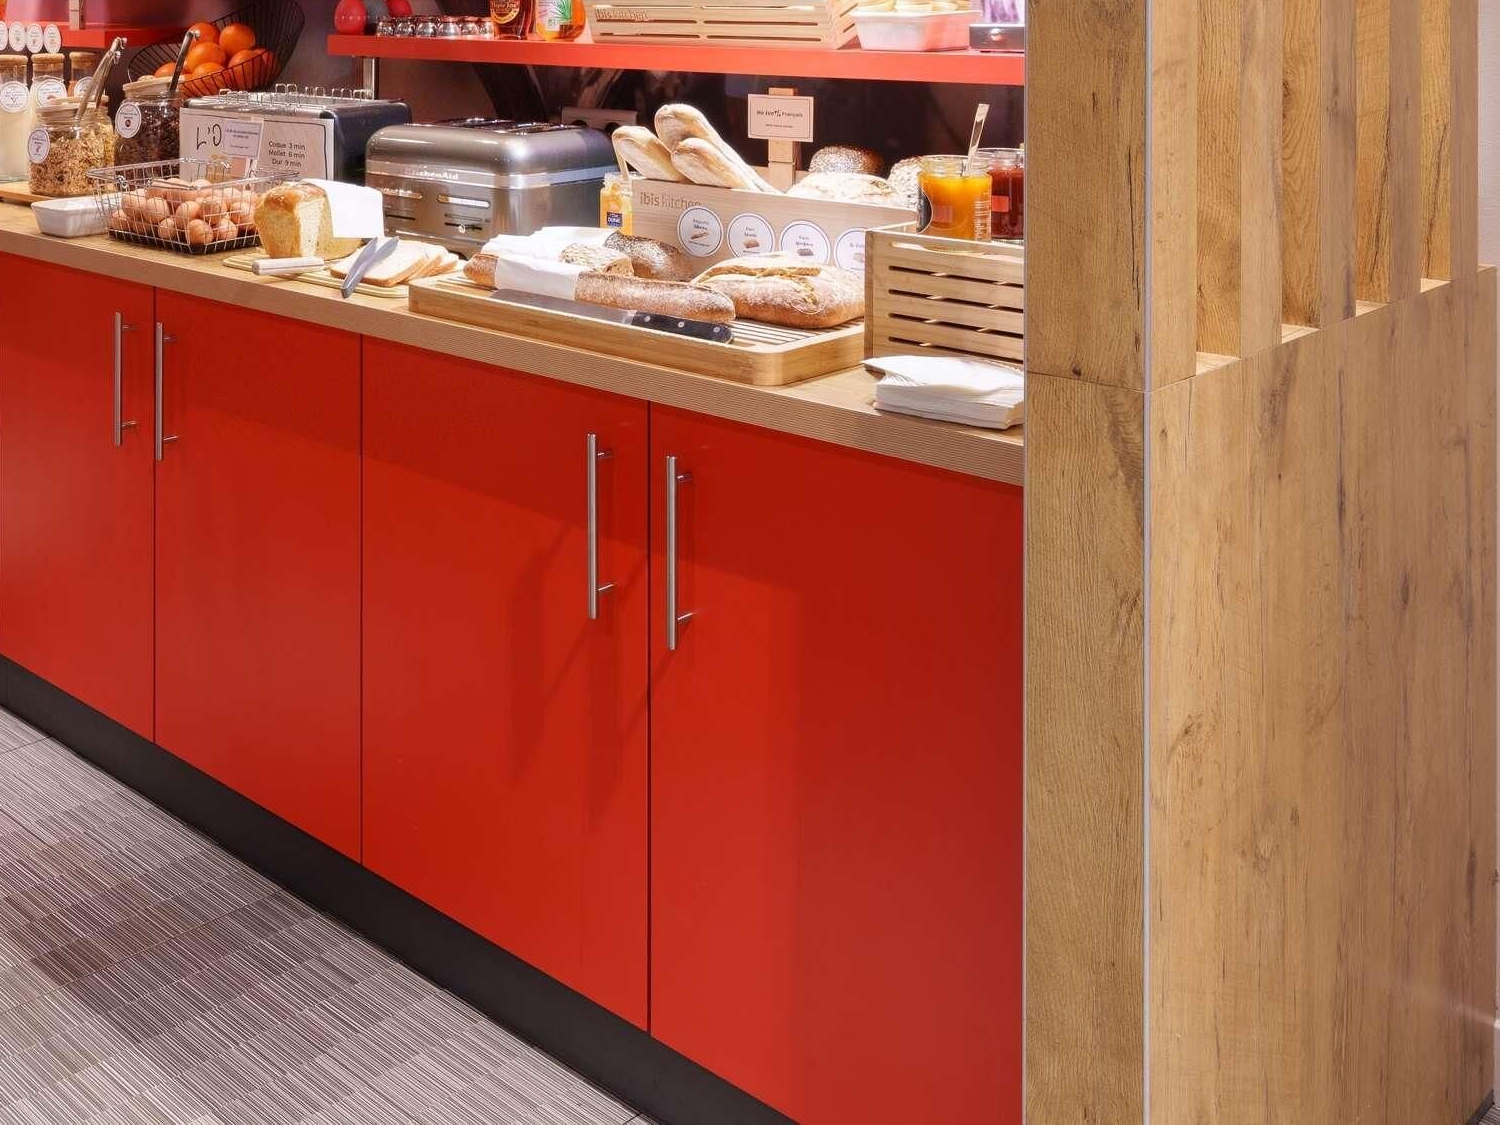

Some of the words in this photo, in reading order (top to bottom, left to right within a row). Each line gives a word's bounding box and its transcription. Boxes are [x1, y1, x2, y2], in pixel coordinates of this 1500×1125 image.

[268, 149, 286, 157] Mollet
[293, 151, 306, 159] min
[405, 167, 459, 181] itchenAid
[640, 192, 660, 206] ibis
